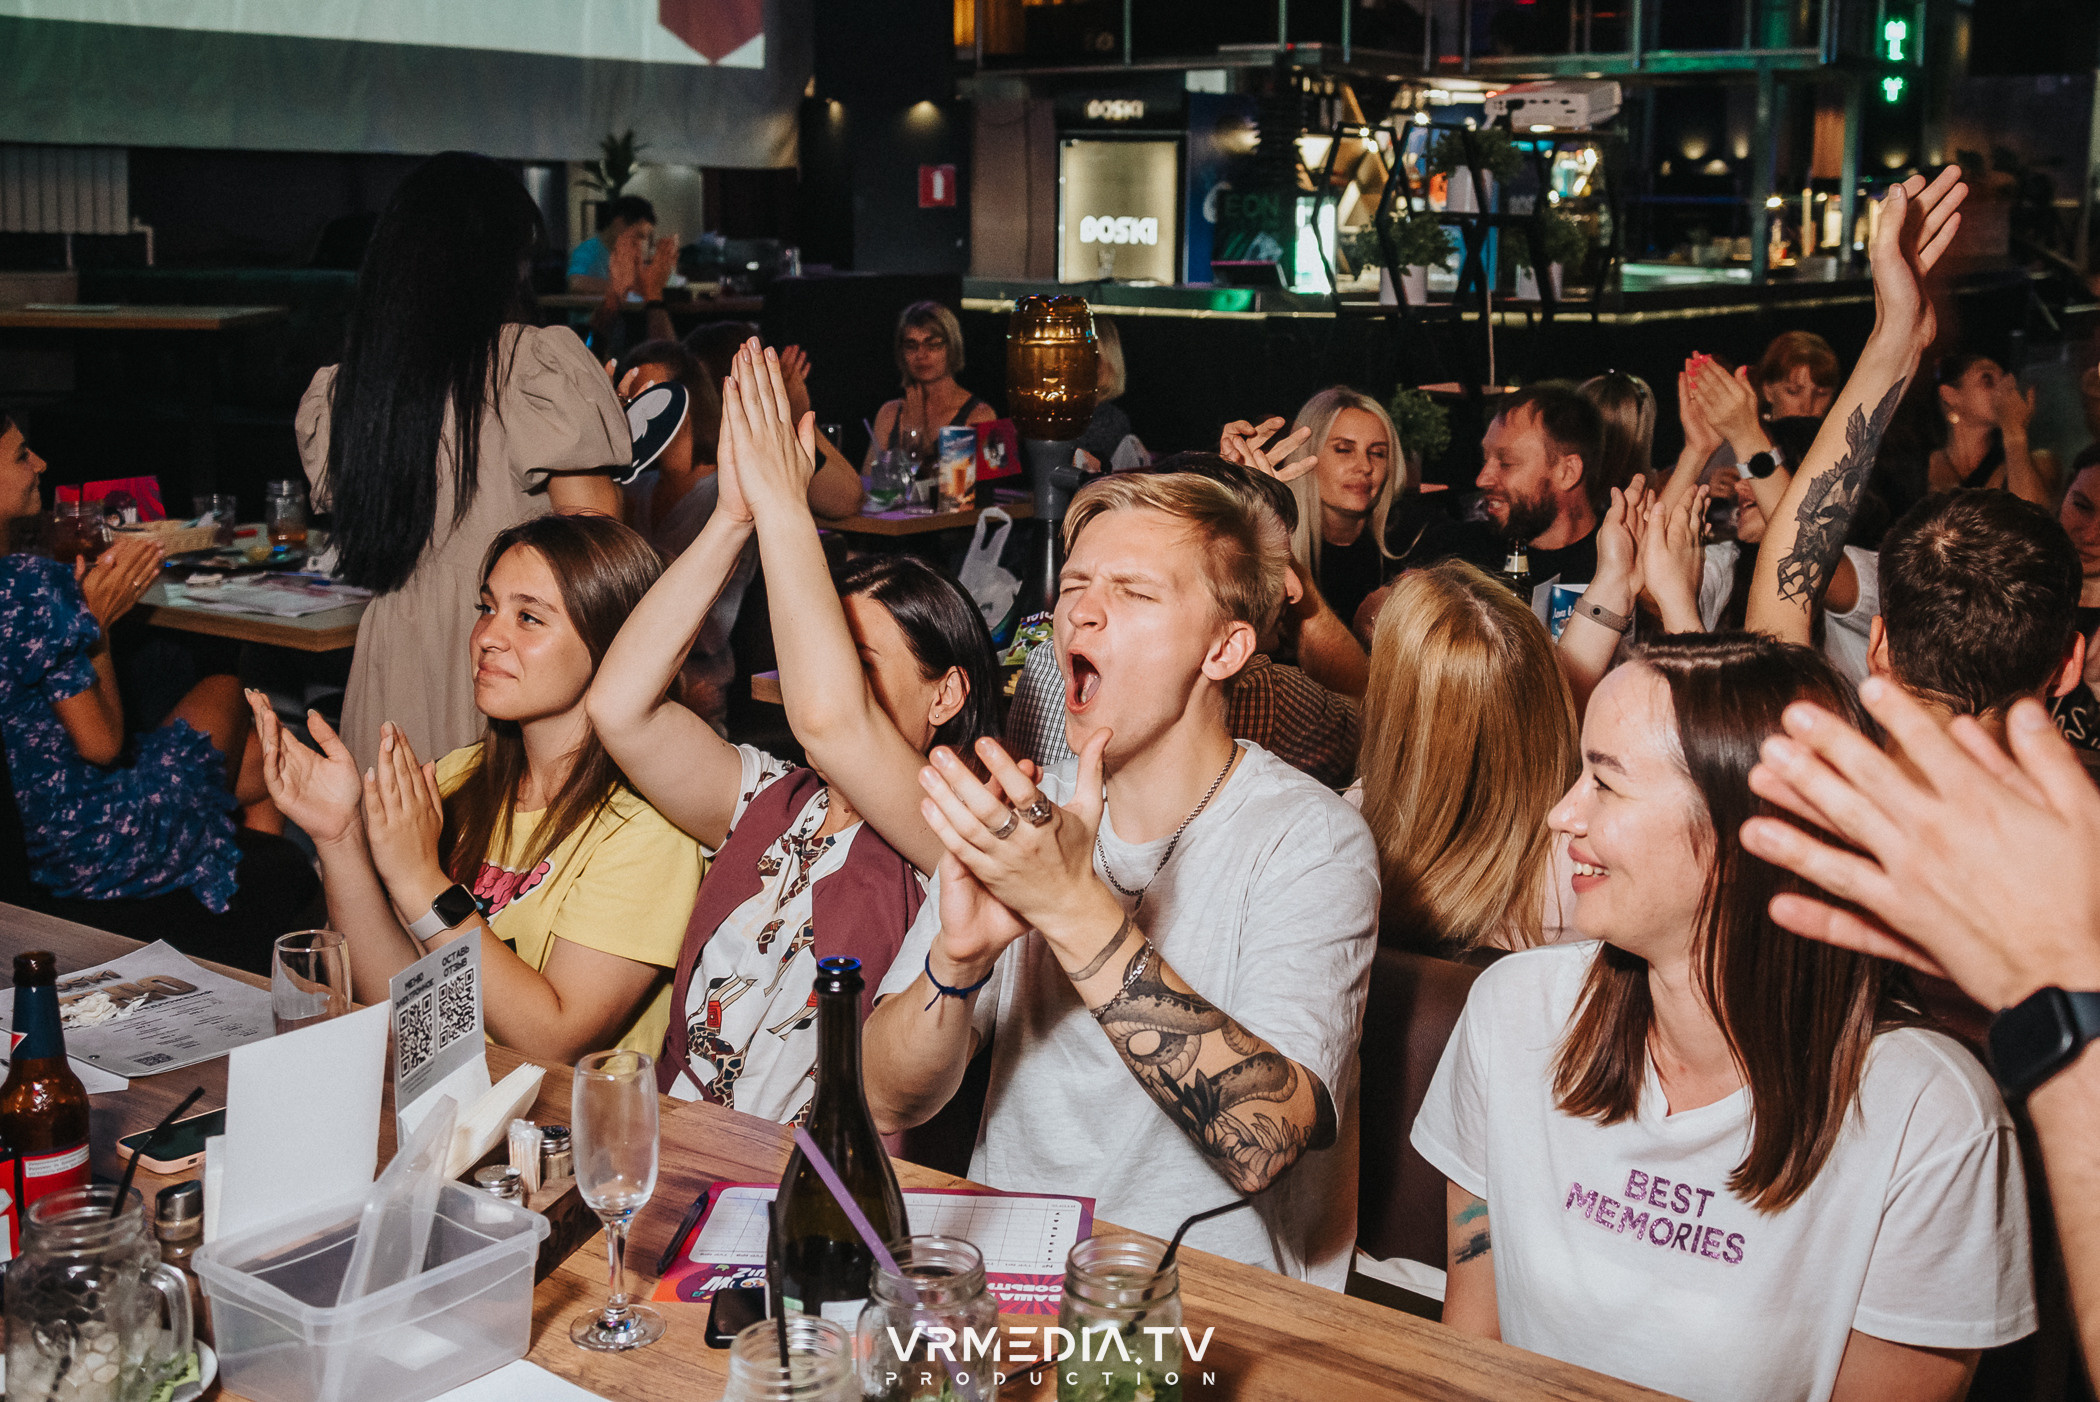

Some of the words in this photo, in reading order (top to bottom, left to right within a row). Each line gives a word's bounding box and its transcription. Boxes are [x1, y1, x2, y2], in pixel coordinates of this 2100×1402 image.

[441, 945, 470, 967] ОСТАВЬ
[443, 957, 468, 977] ОТЗЫВ
[404, 972, 424, 991] МЕНЮ
[1624, 1168, 1715, 1218] BEST
[1564, 1181, 1746, 1265] MEMORIES
[986, 1282, 1063, 1293] СОБЫТИ
